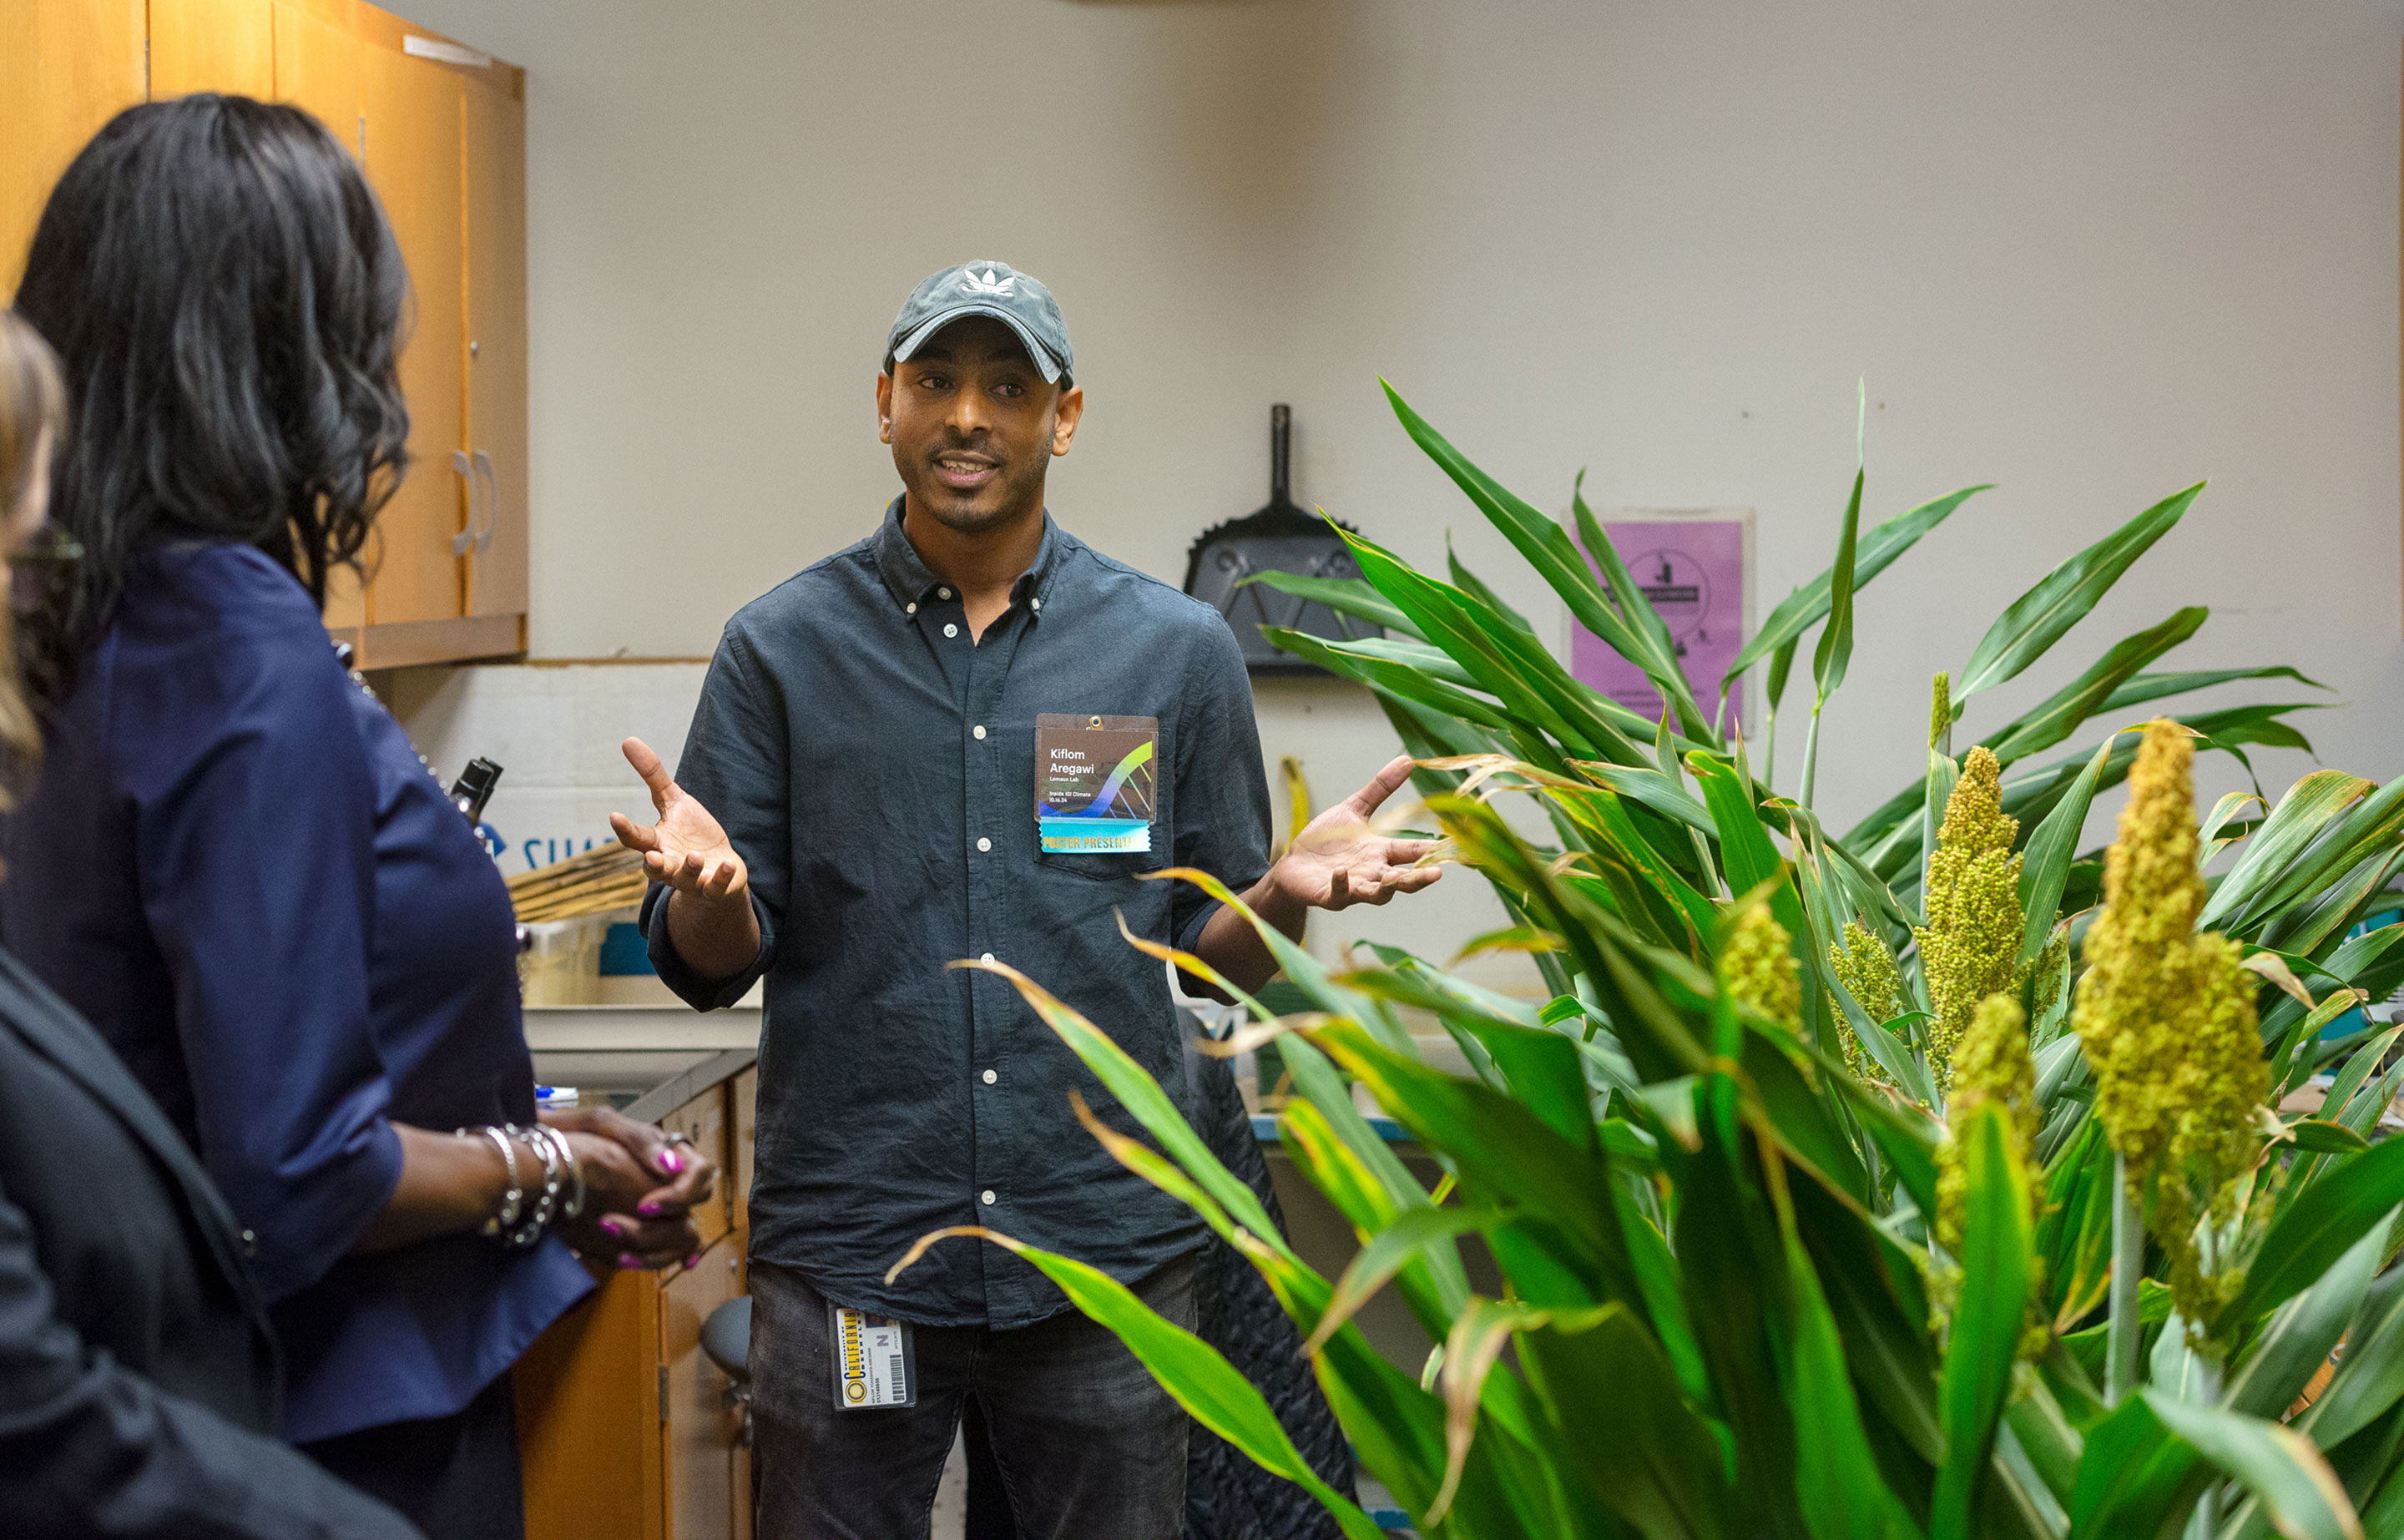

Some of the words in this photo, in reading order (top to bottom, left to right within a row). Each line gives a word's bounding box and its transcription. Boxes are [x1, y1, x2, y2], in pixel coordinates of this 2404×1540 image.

[1050, 748, 1085, 760] Kiflom
[1050, 763, 1094, 775] Aregawi
[1043, 836, 1080, 849] POSTER
[844, 1312, 866, 1380] CALIFORNIA
[856, 1312, 866, 1370] BERKELEY
[876, 1335, 889, 1346] N
